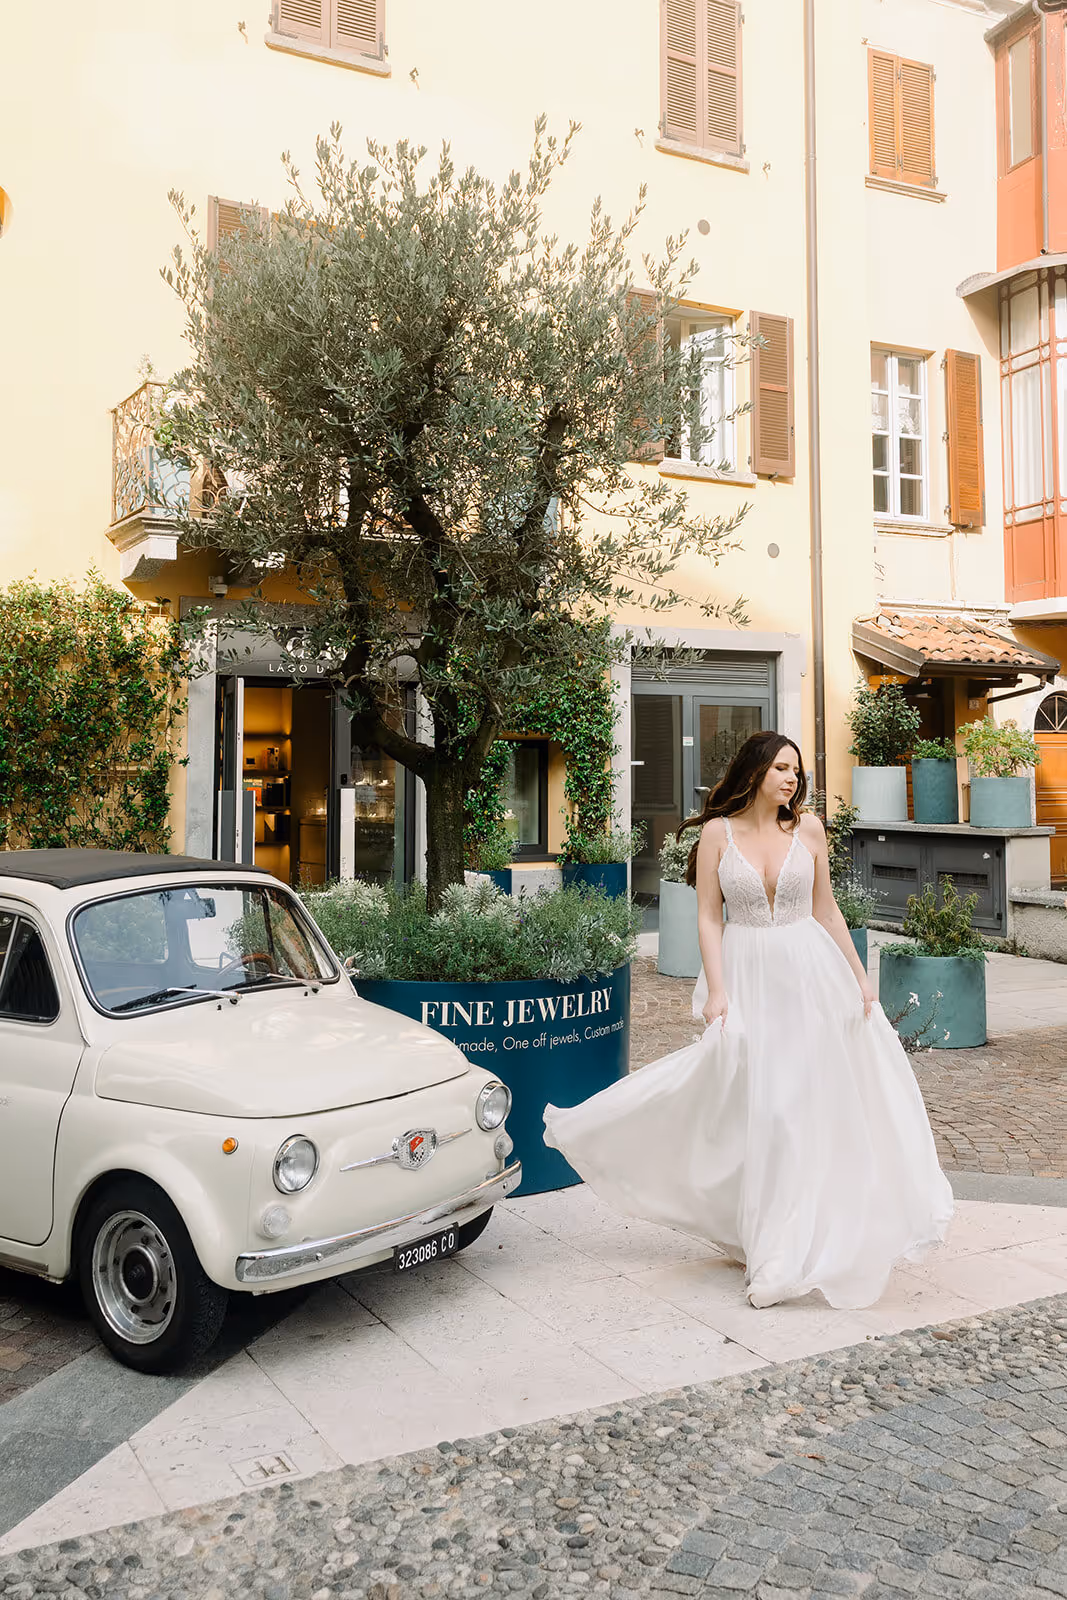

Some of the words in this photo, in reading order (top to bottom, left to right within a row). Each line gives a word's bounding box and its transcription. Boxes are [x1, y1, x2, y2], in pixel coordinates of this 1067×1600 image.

[268, 663, 308, 673] LAGO
[420, 1001, 494, 1027] FINE
[502, 987, 612, 1027] JEWELRY
[502, 1036, 529, 1051] One
[532, 1032, 547, 1048] off
[549, 1028, 582, 1050] jewels,
[584, 1026, 610, 1040] Custom
[398, 1240, 438, 1270] 323086
